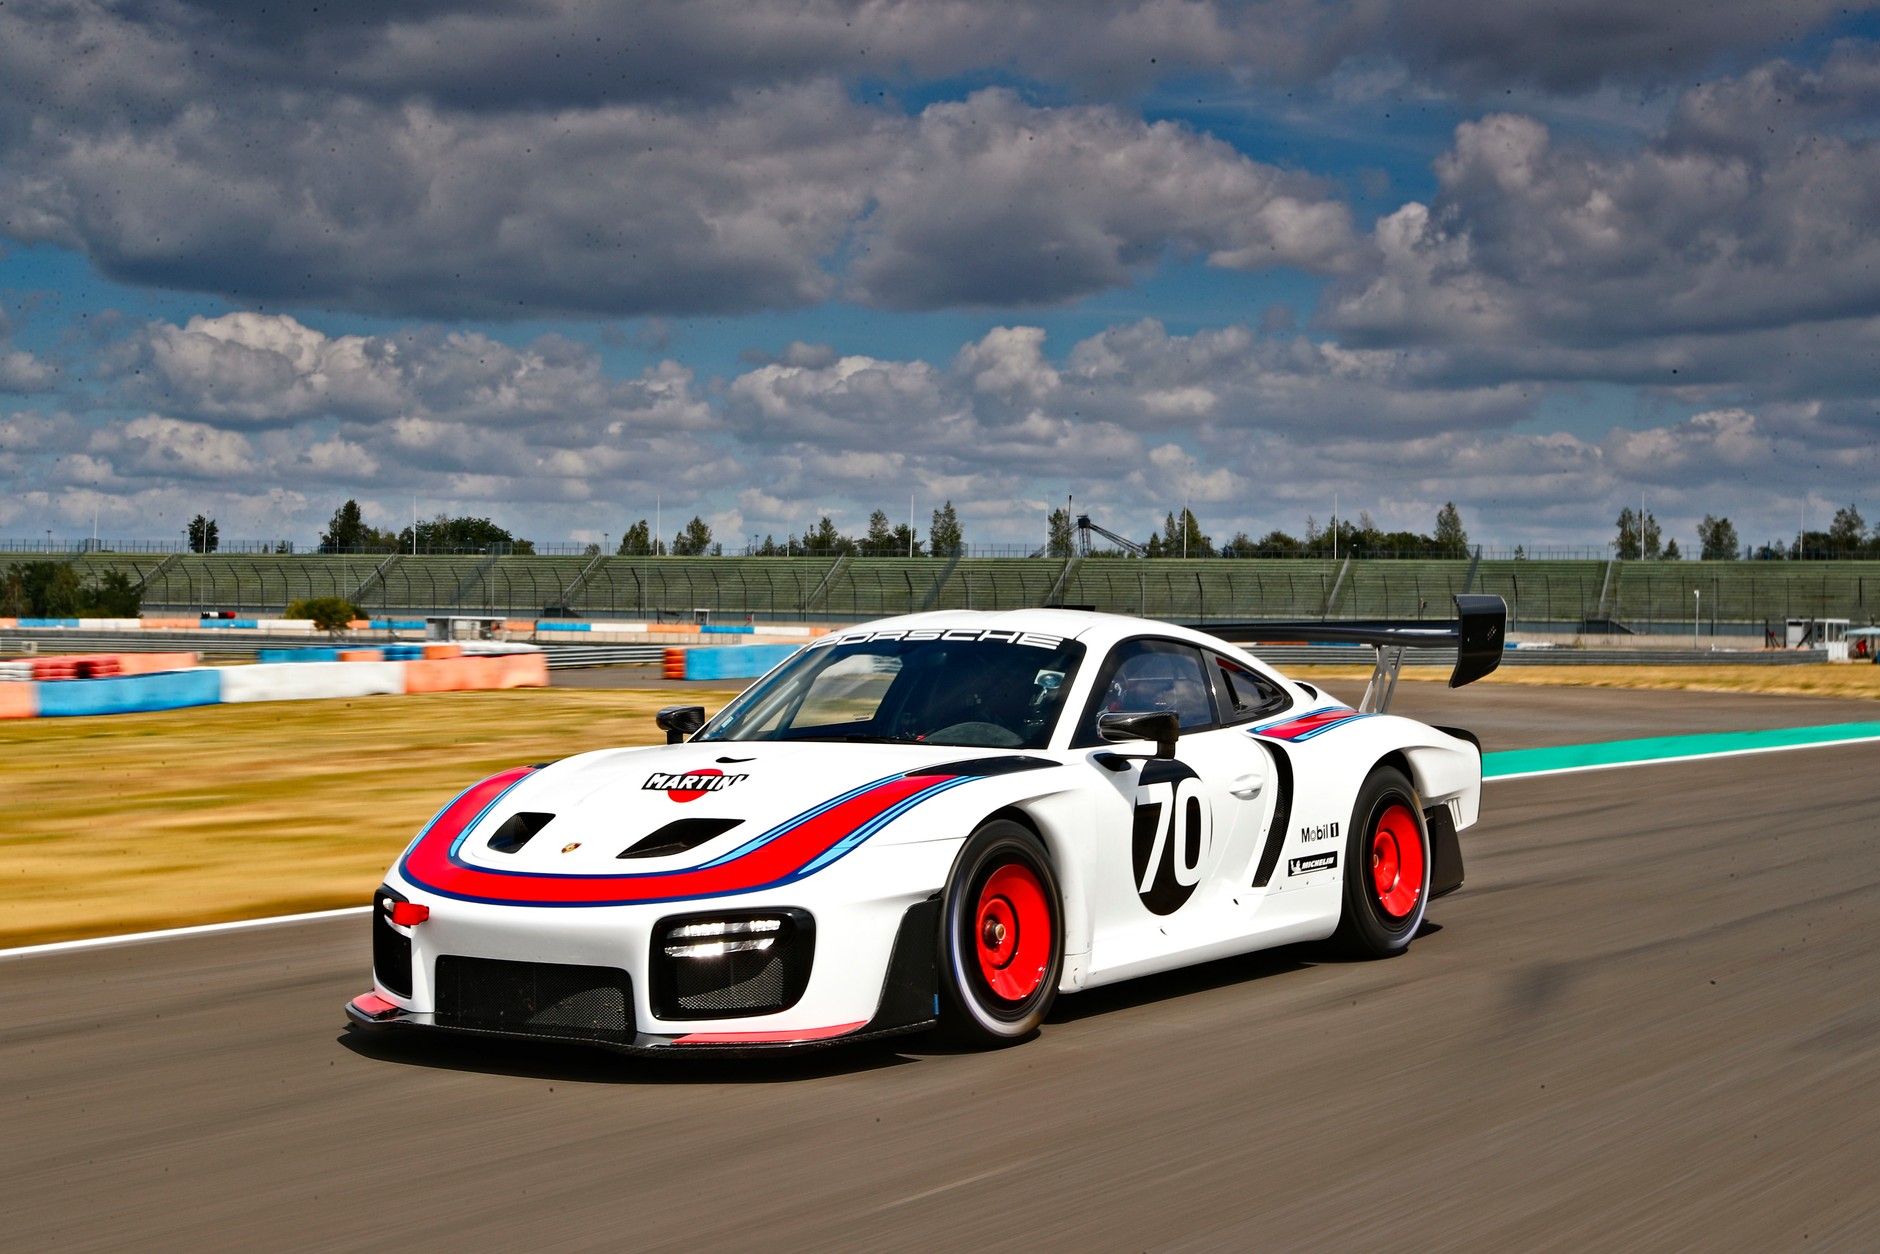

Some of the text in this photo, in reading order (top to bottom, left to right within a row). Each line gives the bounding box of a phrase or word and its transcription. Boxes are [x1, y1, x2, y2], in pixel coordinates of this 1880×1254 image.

[806, 629, 1064, 651] PORSCHE
[1138, 777, 1212, 894] 70
[1301, 822, 1339, 843] Mobil 1
[1301, 856, 1335, 870] MICHELIN
